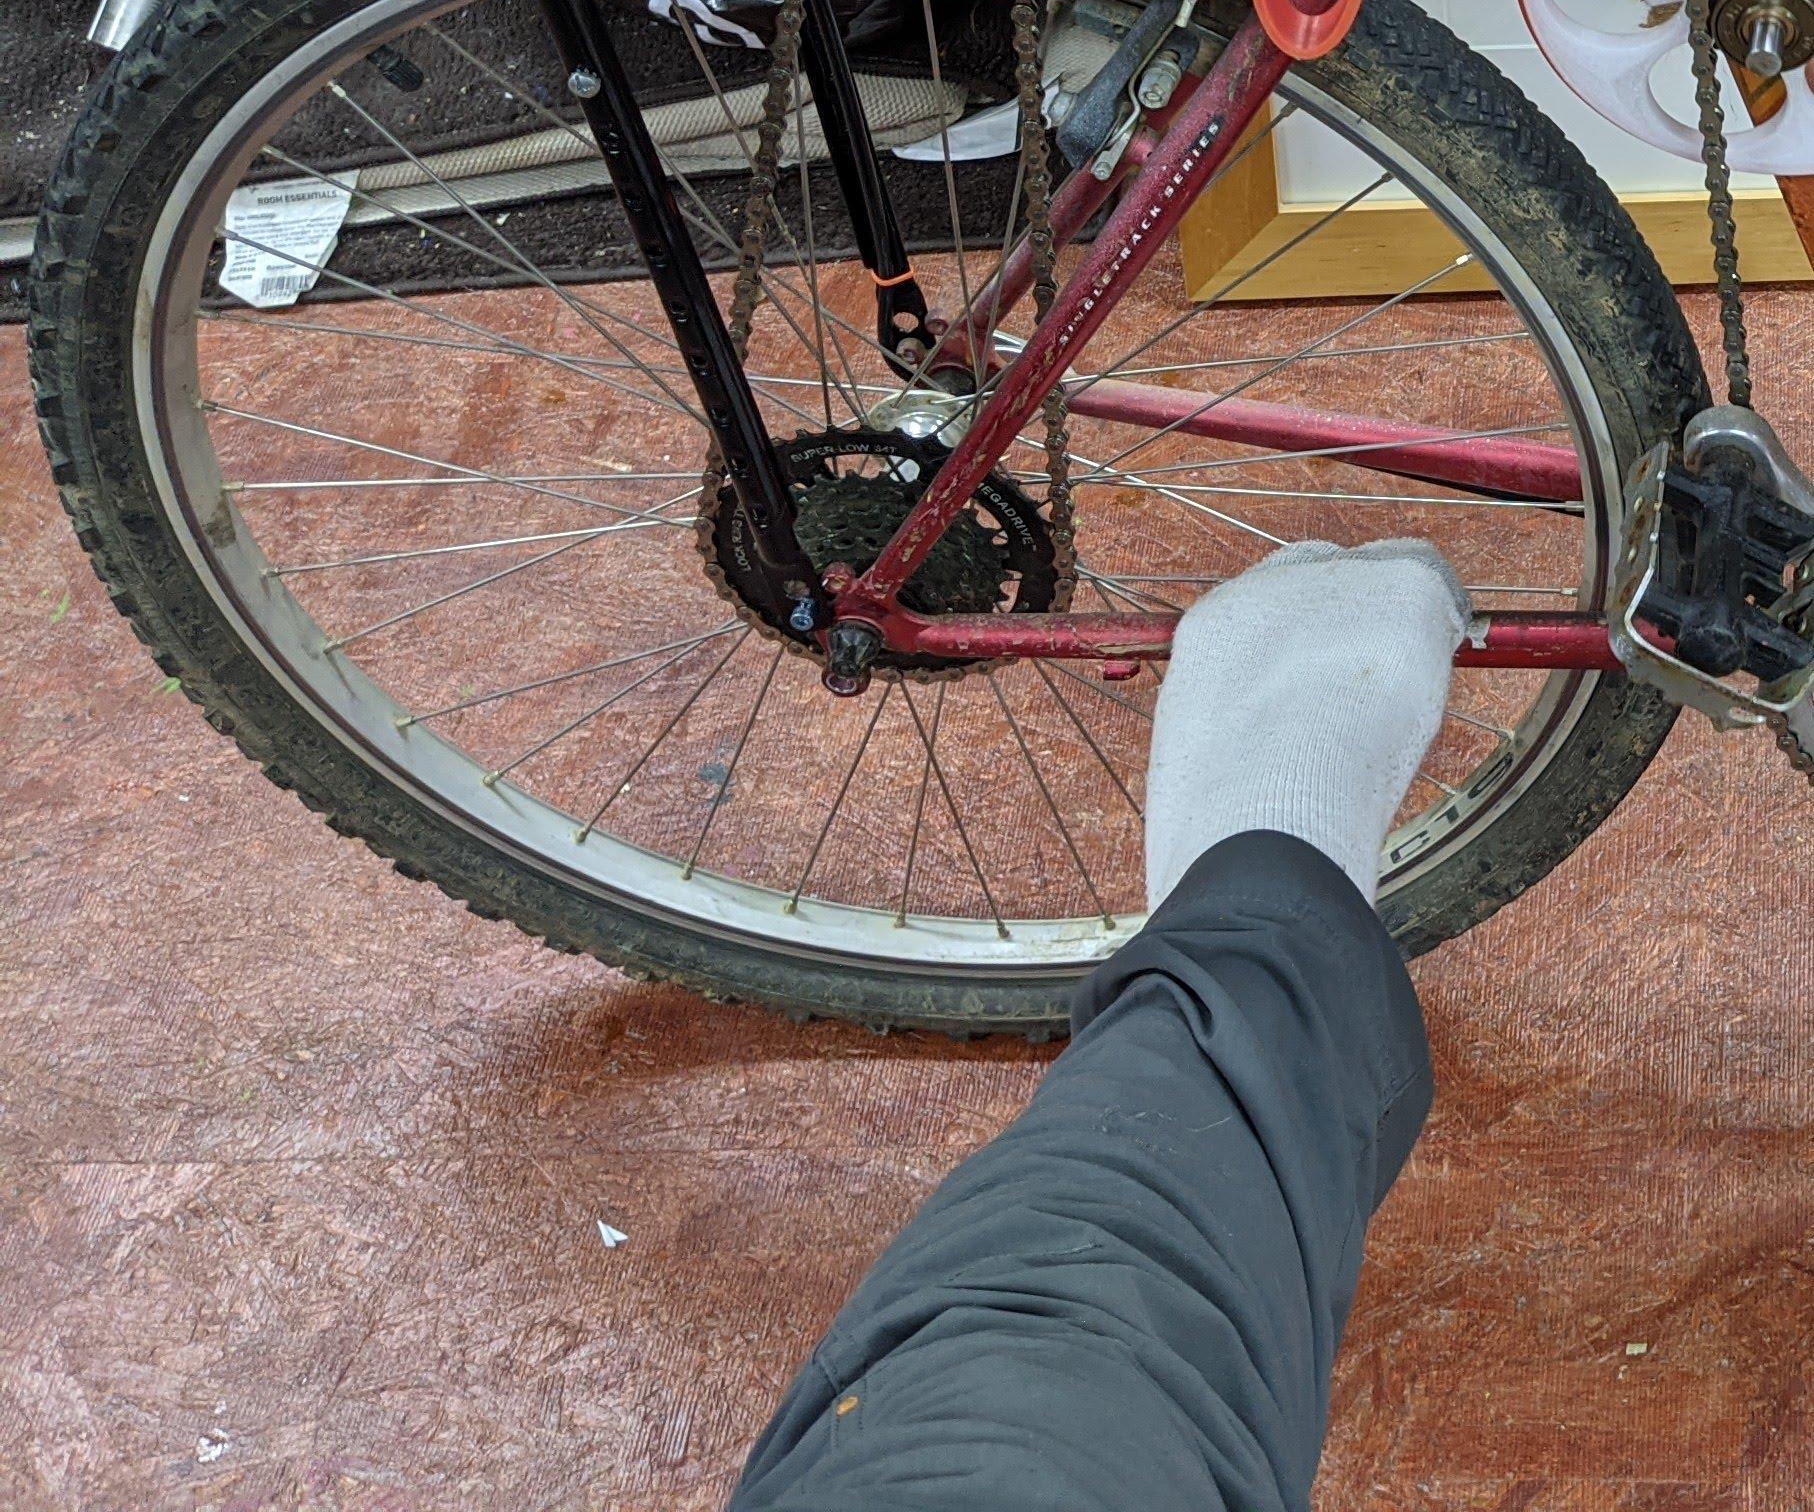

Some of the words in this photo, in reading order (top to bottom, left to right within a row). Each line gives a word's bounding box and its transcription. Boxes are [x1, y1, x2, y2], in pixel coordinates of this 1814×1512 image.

[1164, 123, 1220, 198] SERIES
[256, 194, 284, 206] ROOM
[284, 189, 338, 204] ESSENTIALS
[978, 482, 1034, 546] EGADRIVE
